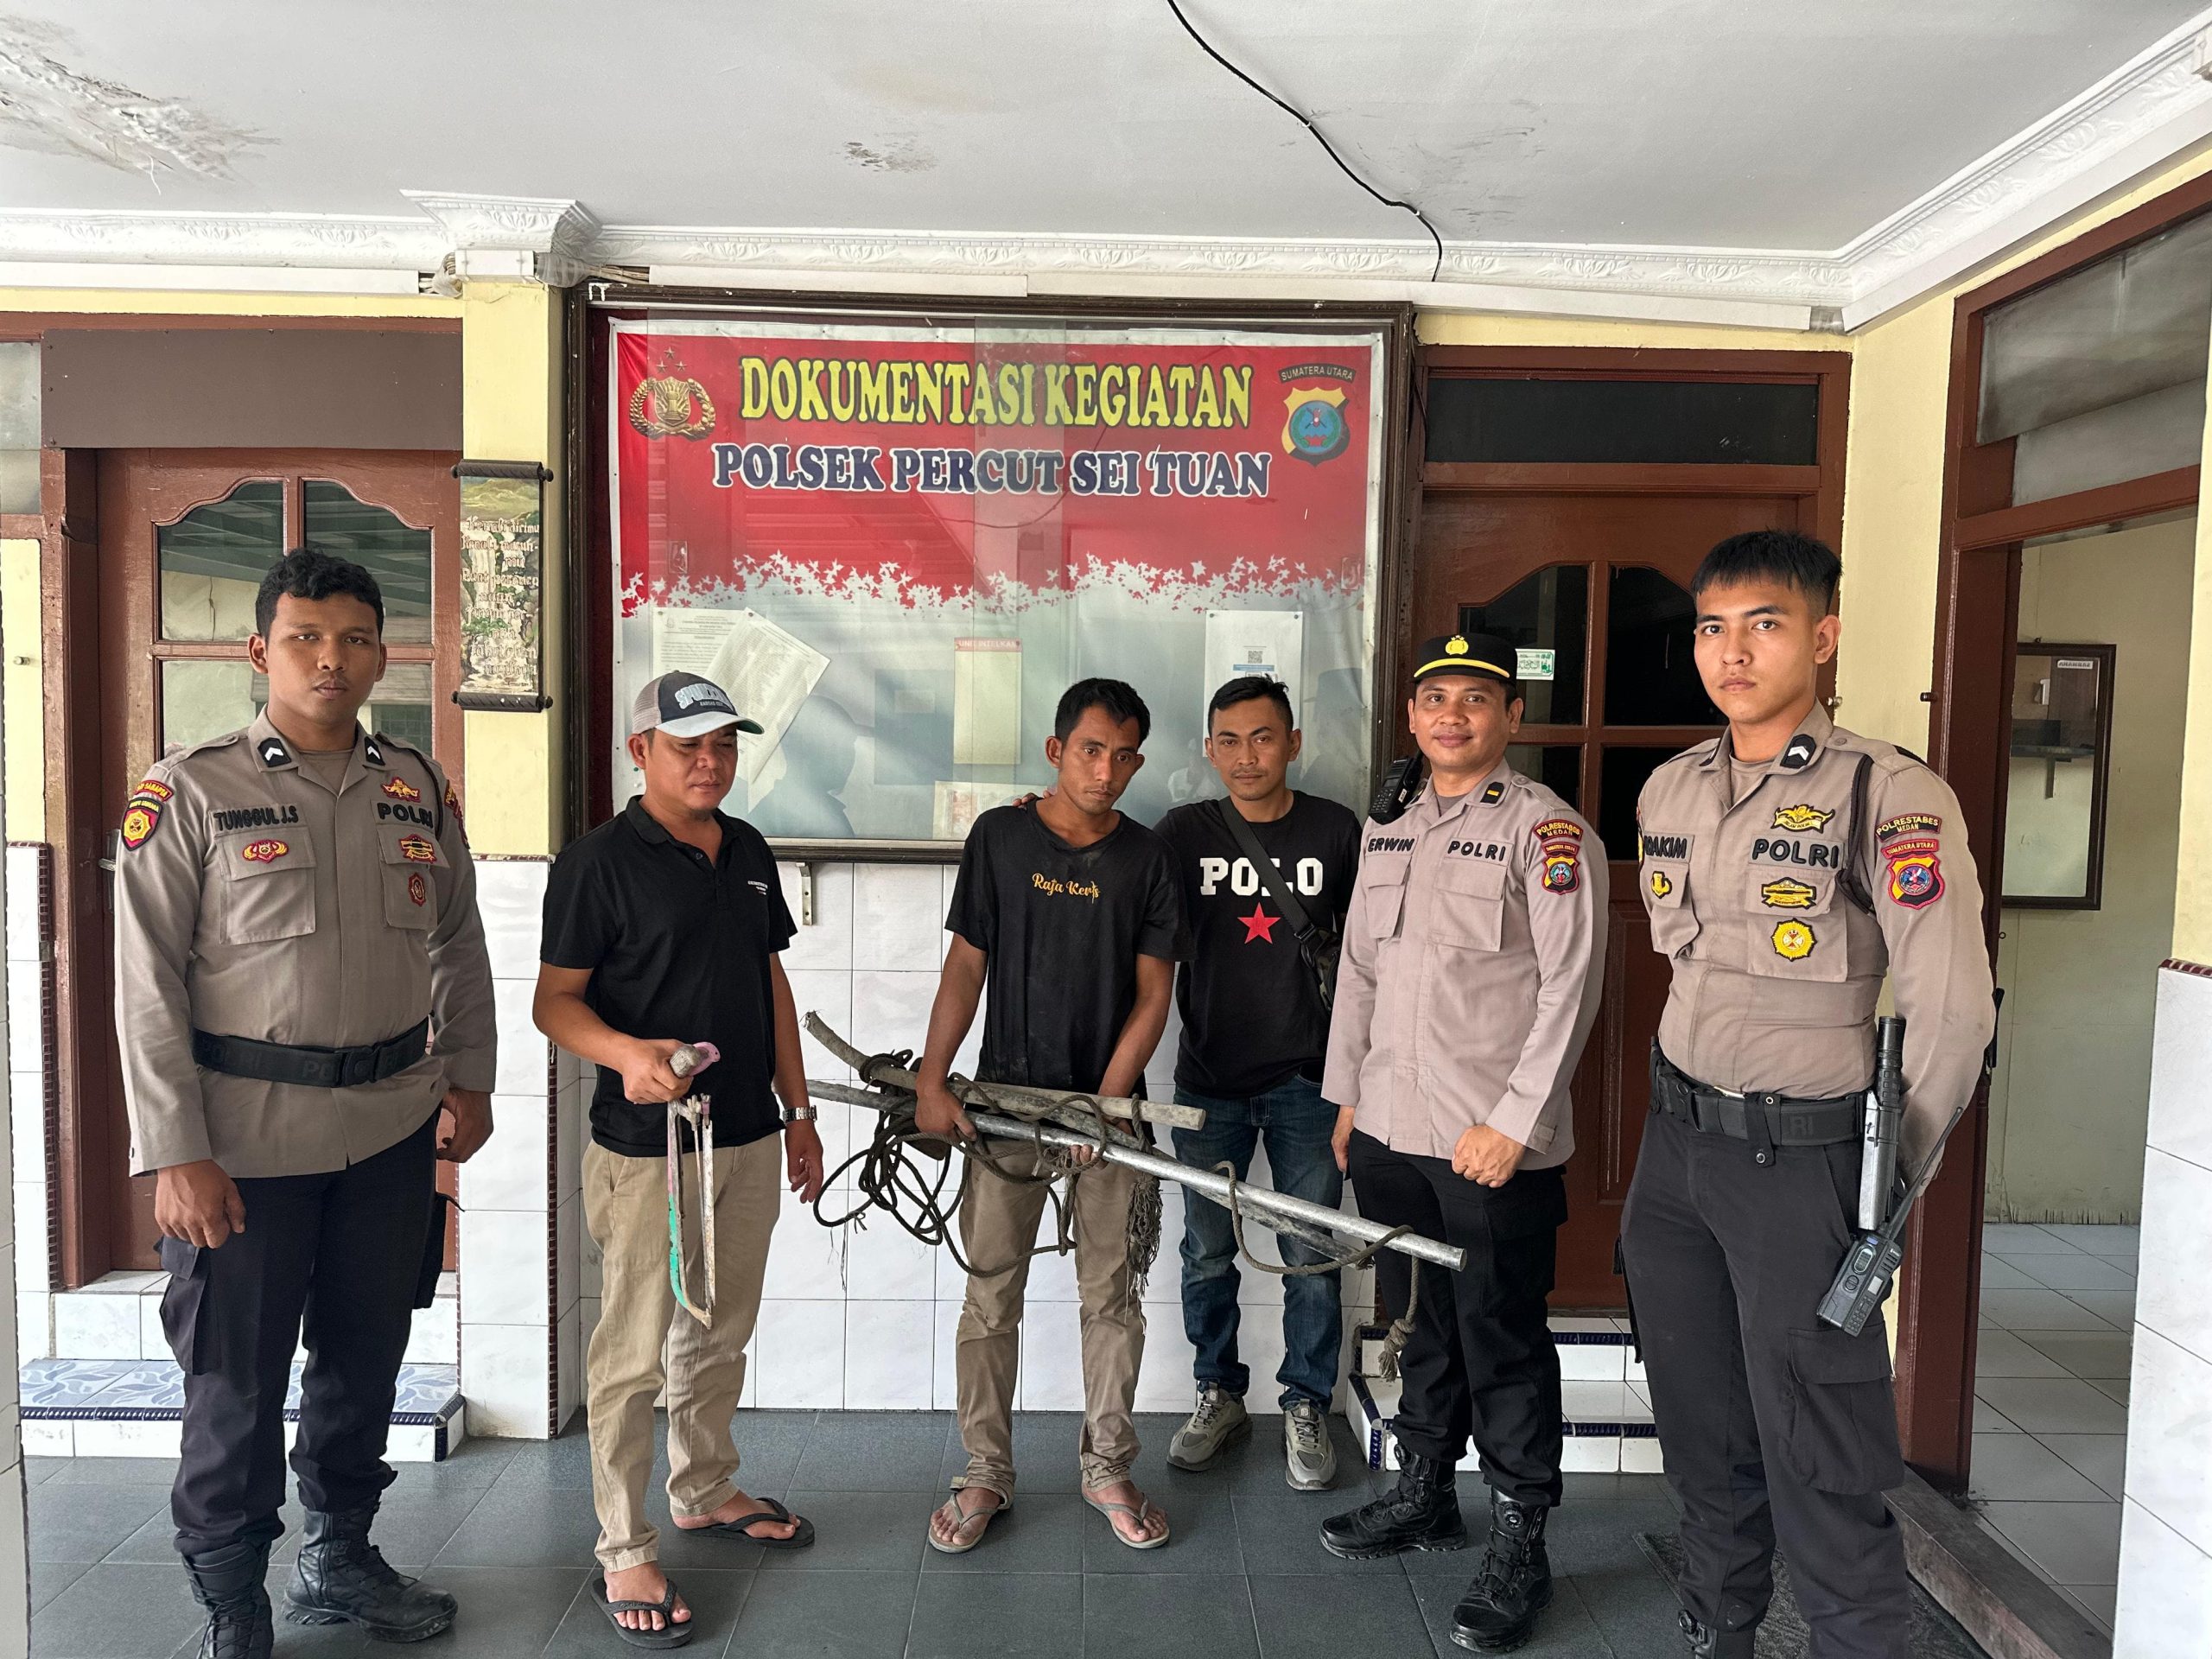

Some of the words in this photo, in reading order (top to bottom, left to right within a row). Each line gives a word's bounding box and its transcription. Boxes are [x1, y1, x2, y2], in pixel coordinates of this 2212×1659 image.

[1281, 365, 1325, 381] SUMATERA
[1326, 366, 1353, 380] UTARA
[739, 355, 1036, 426] DOKUMENTASI
[1043, 362, 1254, 429] KEGIATAN
[711, 442, 886, 492] POLSEK
[890, 448, 1064, 495] PERCUT
[1069, 449, 1141, 497] SEI
[1146, 448, 1272, 498] TUAN
[213, 807, 279, 831] TUNGGUL
[281, 805, 299, 823] J.S
[377, 802, 434, 830] POLRI
[1876, 816, 1939, 836] POLRESTABES
[1536, 822, 1580, 836] POLRESTABES
[1897, 823, 1919, 833] MEDAN
[1367, 837, 1414, 853] ERWIN
[1447, 840, 1506, 861] POLRI
[1751, 838, 1840, 869] POLRI
[1886, 842, 1915, 855] SUMATERA
[1032, 873, 1065, 896] Raja
